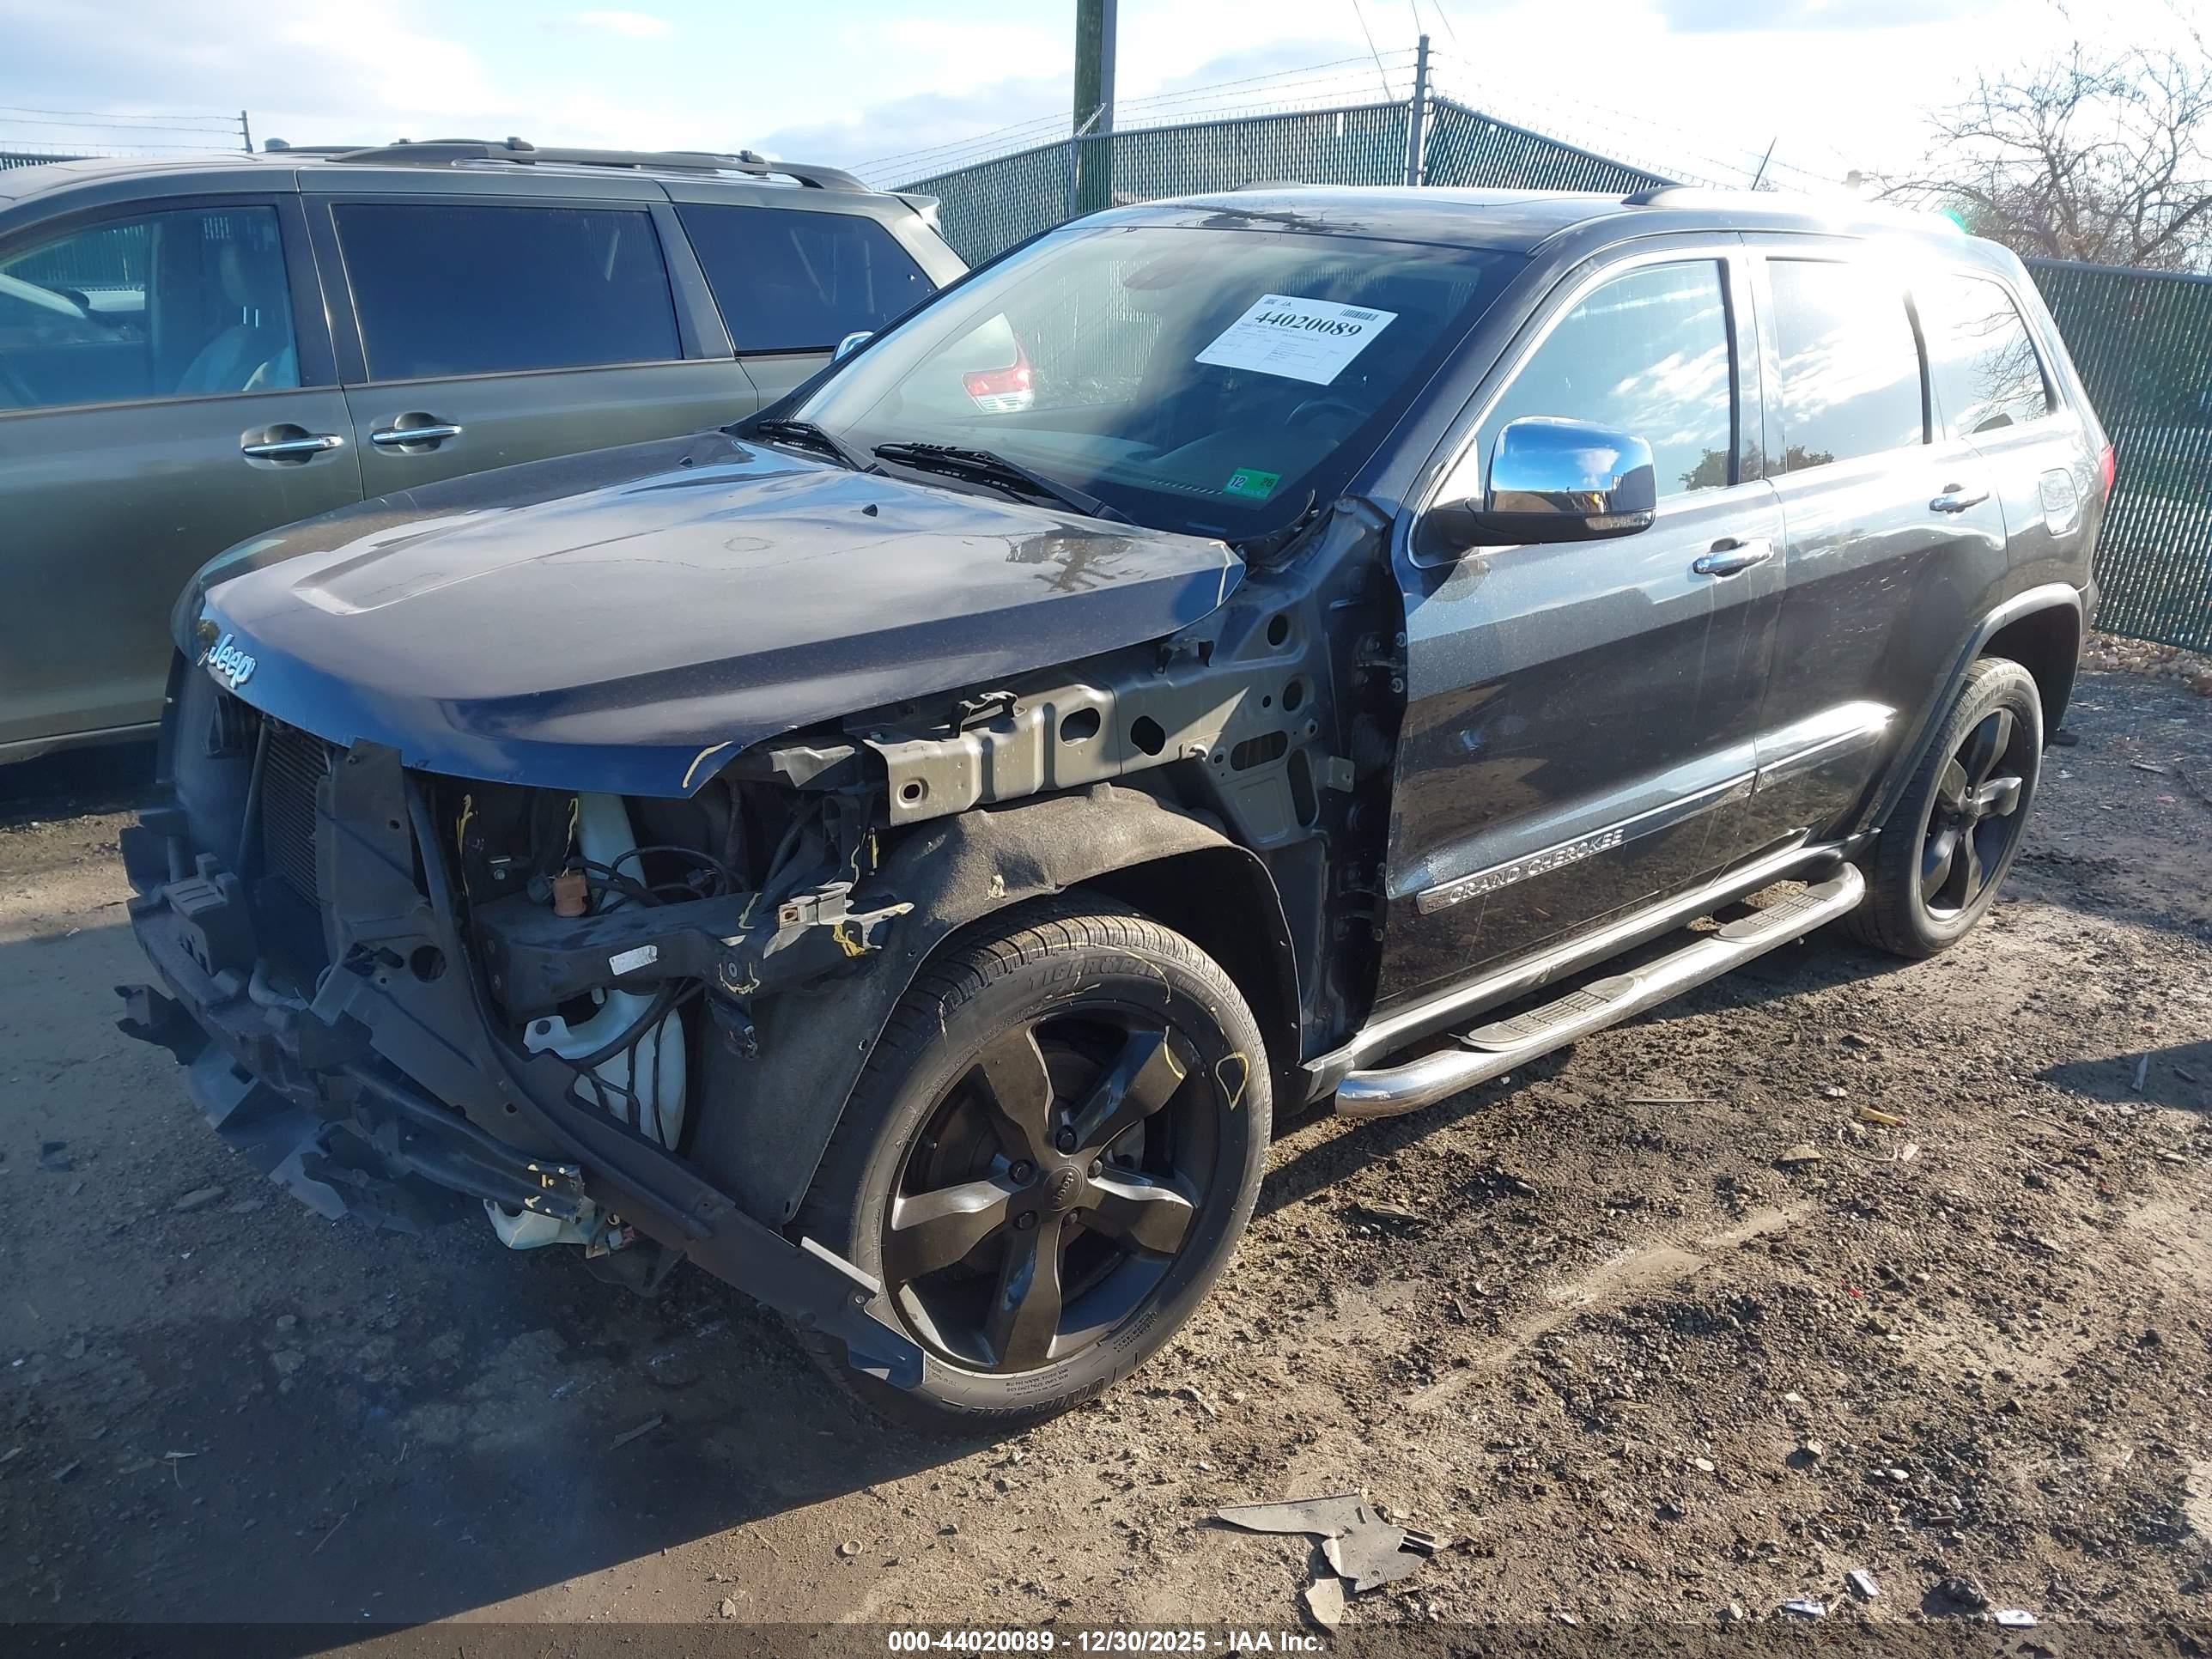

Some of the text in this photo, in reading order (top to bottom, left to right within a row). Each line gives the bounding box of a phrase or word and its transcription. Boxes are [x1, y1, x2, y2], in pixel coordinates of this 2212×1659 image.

[1255, 310, 1363, 337] 44020089
[1231, 476, 1246, 488] 12
[207, 633, 256, 690] Jeep
[1449, 829, 1625, 904] GRAND CHEROKEE
